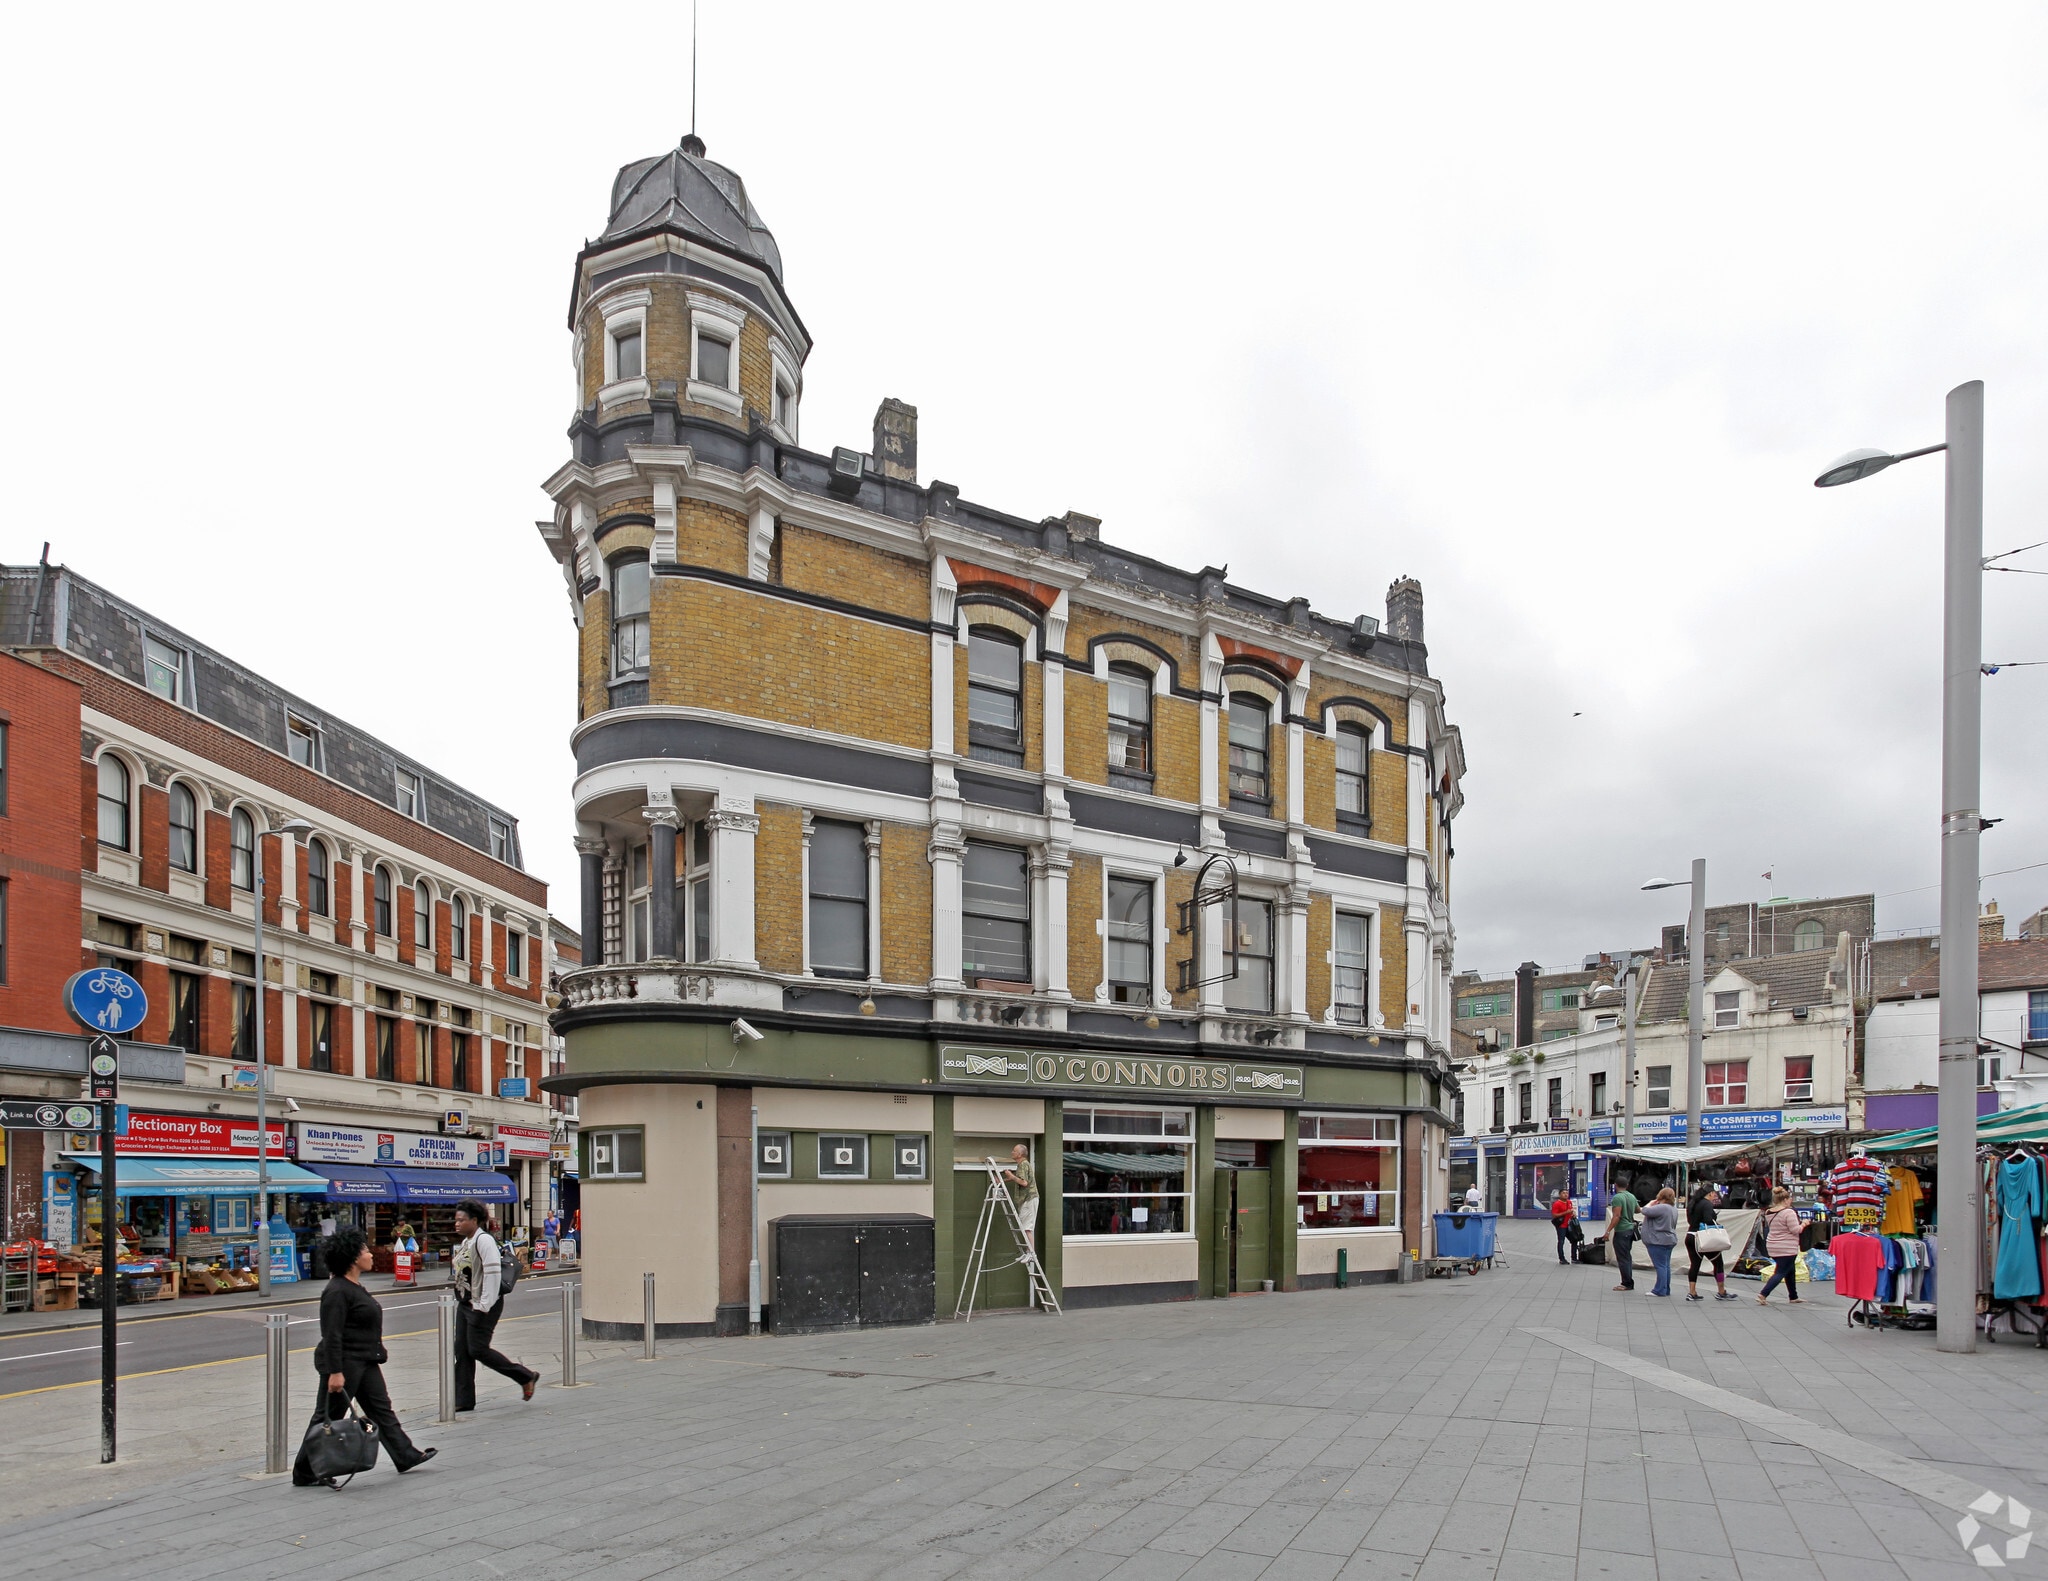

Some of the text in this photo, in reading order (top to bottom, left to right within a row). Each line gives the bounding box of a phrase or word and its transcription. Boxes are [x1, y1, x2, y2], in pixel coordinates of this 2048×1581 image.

[1035, 1056, 1228, 1090] O'CONNORS
[1702, 1117, 1709, 1125] &
[1712, 1115, 1777, 1124] COSMETICS
[1783, 1113, 1842, 1124] Lycamobile
[128, 1116, 222, 1136] fectionary Box
[1619, 1121, 1668, 1129] Lamobile
[307, 1129, 363, 1141] Khan Phones
[419, 1138, 456, 1150] AFRICAN
[1514, 1138, 1532, 1150] CAFE
[1533, 1134, 1571, 1148] SANDWICH
[409, 1148, 465, 1160] CASH & CARRY
[423, 1187, 440, 1195] Money
[1846, 1208, 1876, 1217] £3.99
